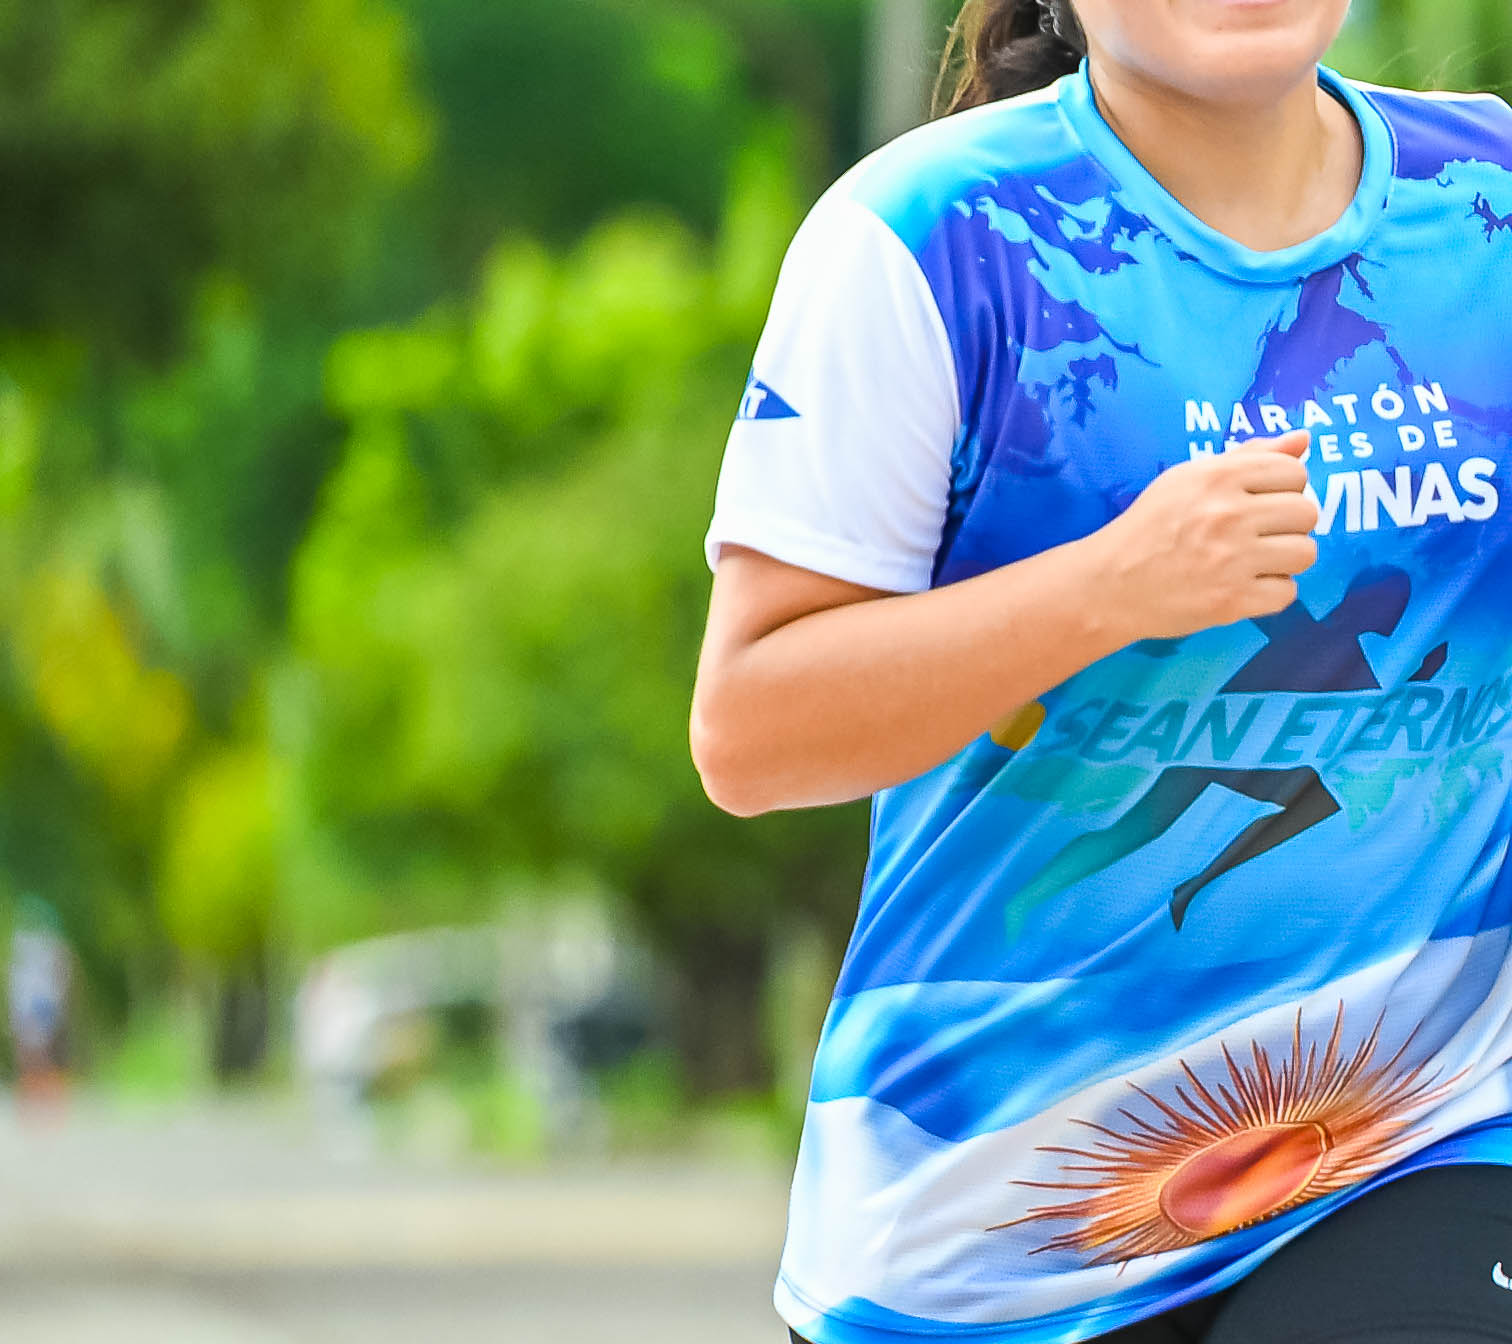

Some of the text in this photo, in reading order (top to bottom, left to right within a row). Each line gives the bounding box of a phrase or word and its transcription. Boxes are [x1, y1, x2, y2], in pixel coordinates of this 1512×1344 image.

[1184, 382, 1450, 434] MARATÓN
[1397, 419, 1458, 452] DE
[1304, 457, 1499, 536] VINAS
[1044, 697, 1262, 764] SEAN
